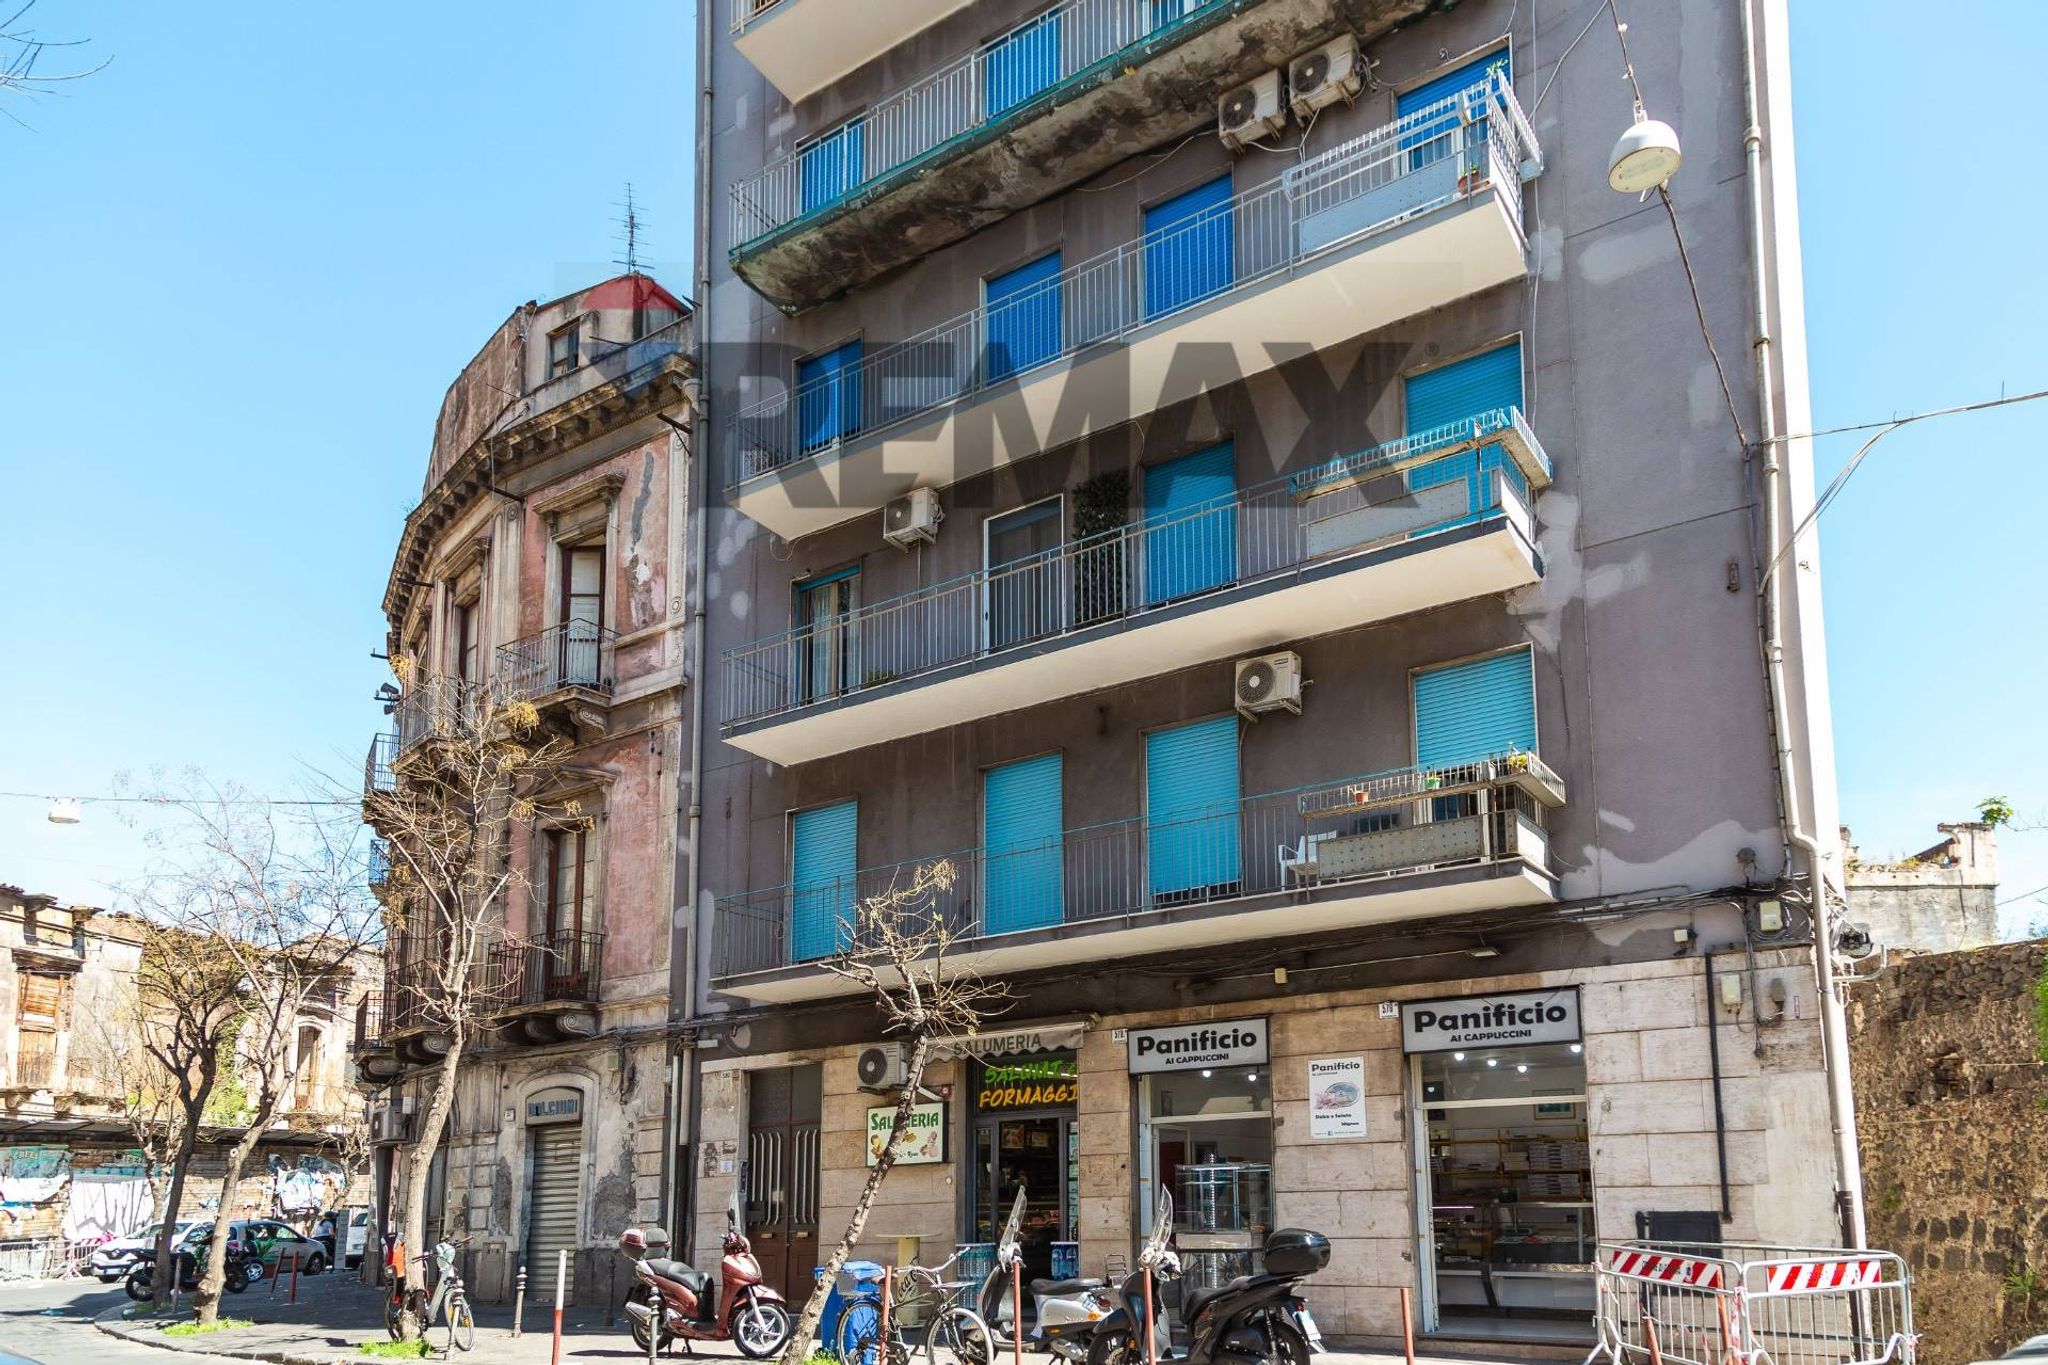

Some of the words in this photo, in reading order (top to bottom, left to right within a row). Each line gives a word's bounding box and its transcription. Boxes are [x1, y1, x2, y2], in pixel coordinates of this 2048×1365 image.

[1414, 1001, 1567, 1033] Panificio
[953, 1033, 1042, 1056] SALUMERIA
[1137, 1028, 1257, 1056] Panificio
[1450, 1034, 1462, 1043] AI
[1464, 1029, 1532, 1042] CAPPUCCINI
[1165, 1057, 1174, 1065] AI
[1176, 1052, 1229, 1064] CAPPUCCINI
[1311, 1061, 1361, 1072] Panificio
[979, 1083, 1078, 1108] FORMAGGI
[870, 1111, 939, 1131] SALERIA
